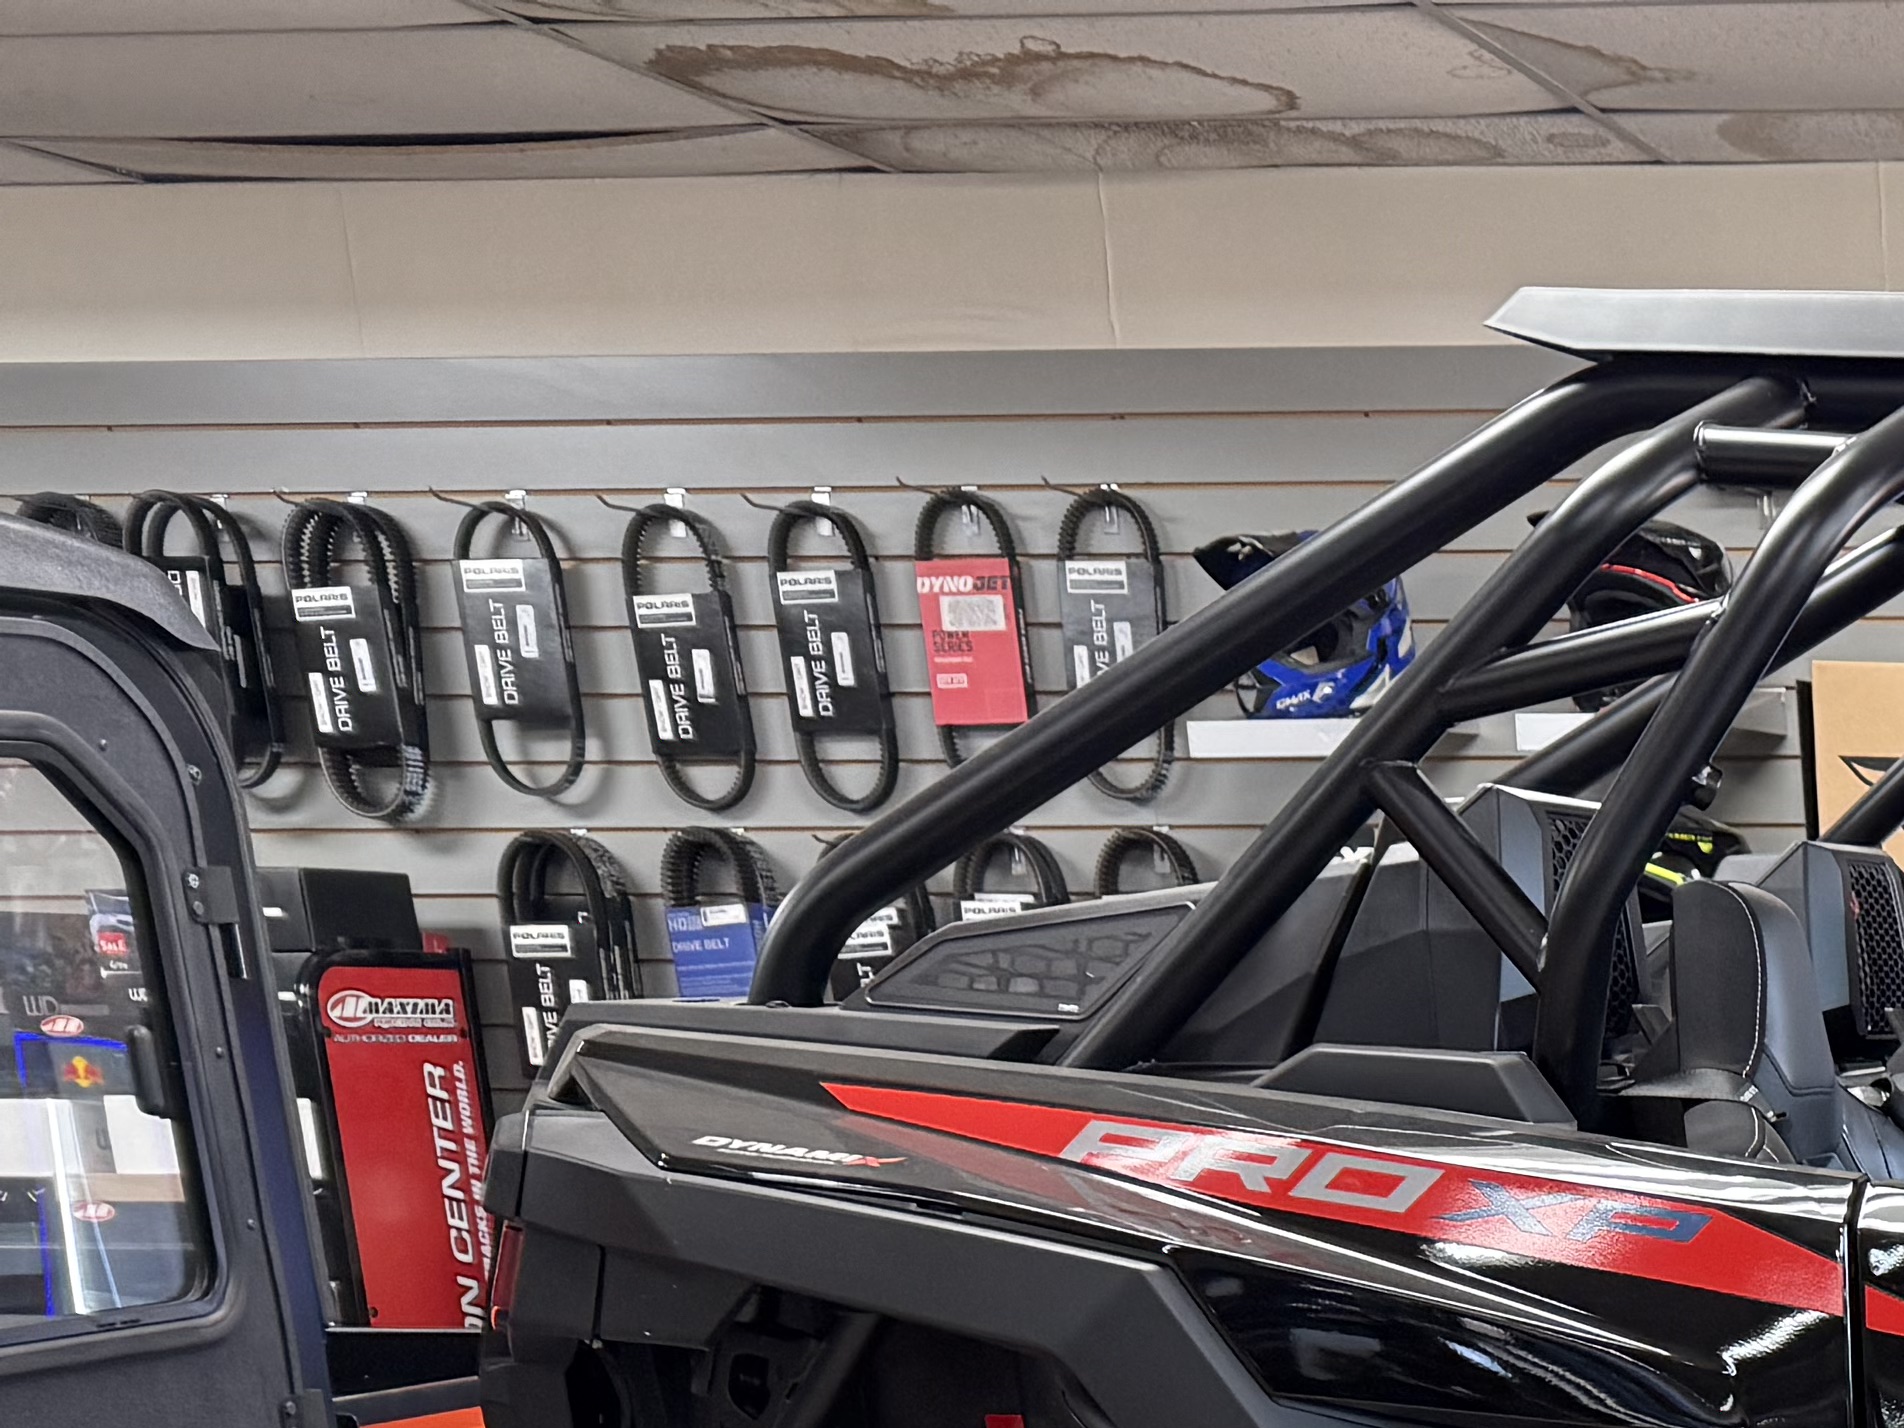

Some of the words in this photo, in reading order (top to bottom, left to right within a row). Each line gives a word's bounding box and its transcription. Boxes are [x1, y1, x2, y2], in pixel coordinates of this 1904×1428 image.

[464, 566, 520, 576] POLARIS
[780, 576, 833, 587] POLARIS
[916, 575, 1010, 594] DYNOJET
[1068, 566, 1122, 576] POLARIS
[295, 592, 348, 603] POLARIS
[637, 600, 690, 610] POLARIS
[488, 598, 510, 645] BELT
[804, 609, 823, 656] BELT
[1091, 599, 1109, 644] BELT
[320, 625, 342, 672] BELT
[661, 633, 682, 679] BELT
[497, 649, 519, 704] DRIVE
[811, 659, 834, 717] DRIVE
[330, 676, 353, 732] DRIVE
[670, 683, 693, 740] DRIVE
[704, 937, 740, 949] BELT
[536, 963, 555, 1006] BELT
[363, 997, 454, 1018] MAXIMA
[408, 1034, 458, 1043] DEALER
[453, 1060, 474, 1134] WORLD.
[423, 1062, 476, 1263] CENTER
[464, 1137, 481, 1175] THE
[692, 1135, 908, 1168] DYNAMIX
[1061, 1120, 1446, 1213] PRO
[1433, 1179, 1713, 1244] XP
